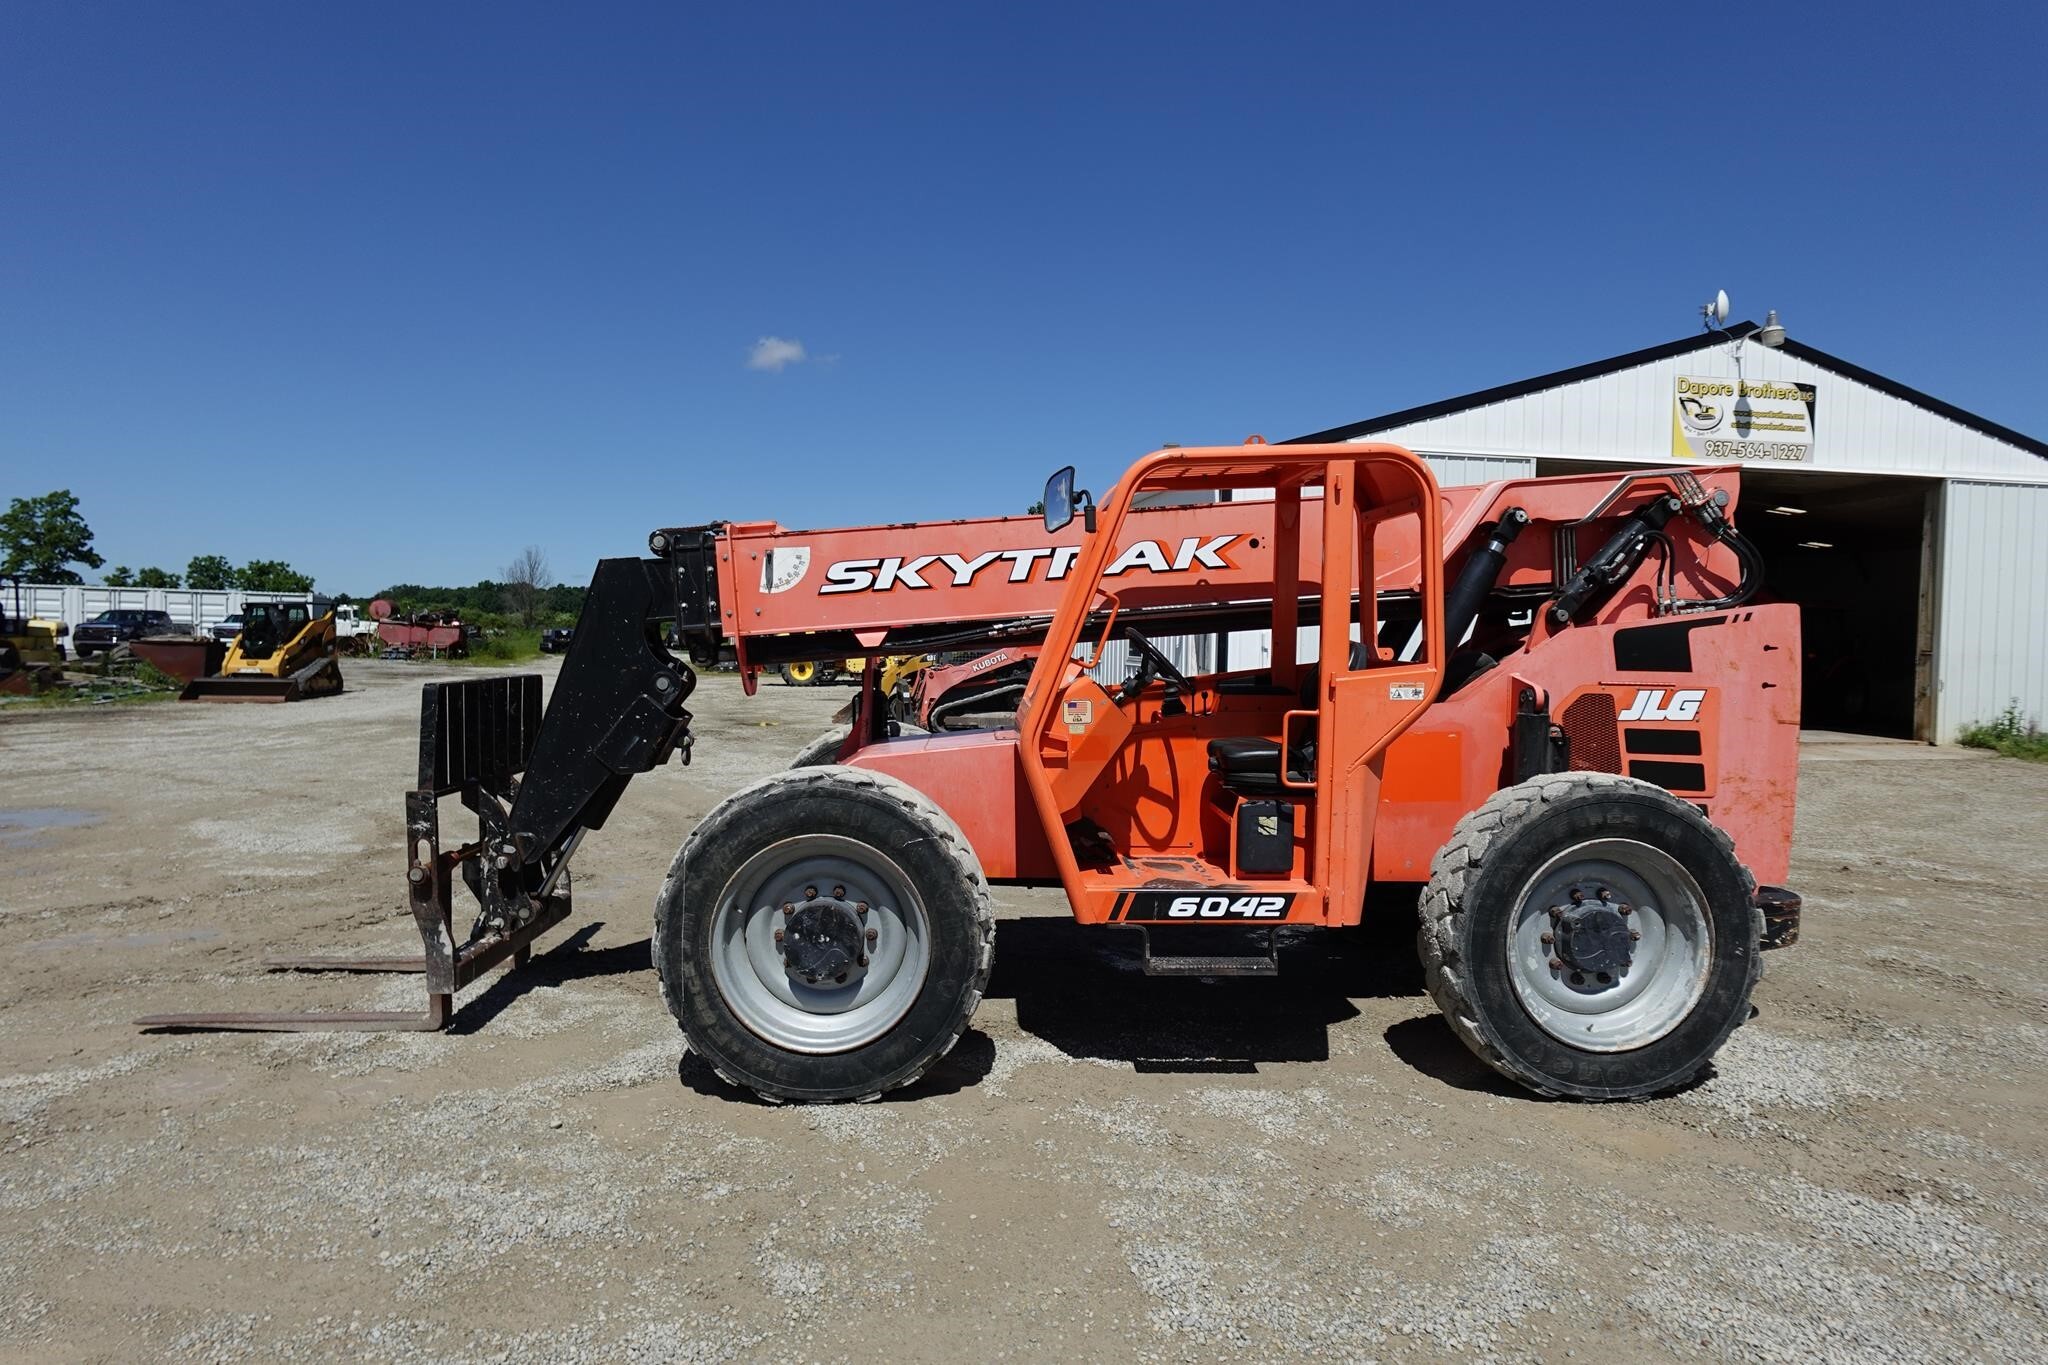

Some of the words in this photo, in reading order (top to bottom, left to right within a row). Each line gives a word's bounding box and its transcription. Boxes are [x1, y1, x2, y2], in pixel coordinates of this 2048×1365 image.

[1677, 377, 1734, 398] Dapore
[1738, 379, 1799, 401] Brothers
[1705, 440, 1808, 461] 937-564-1227
[972, 653, 1008, 672] KUBOTA
[1616, 689, 1707, 721] JLG
[1168, 897, 1286, 917] 6042
